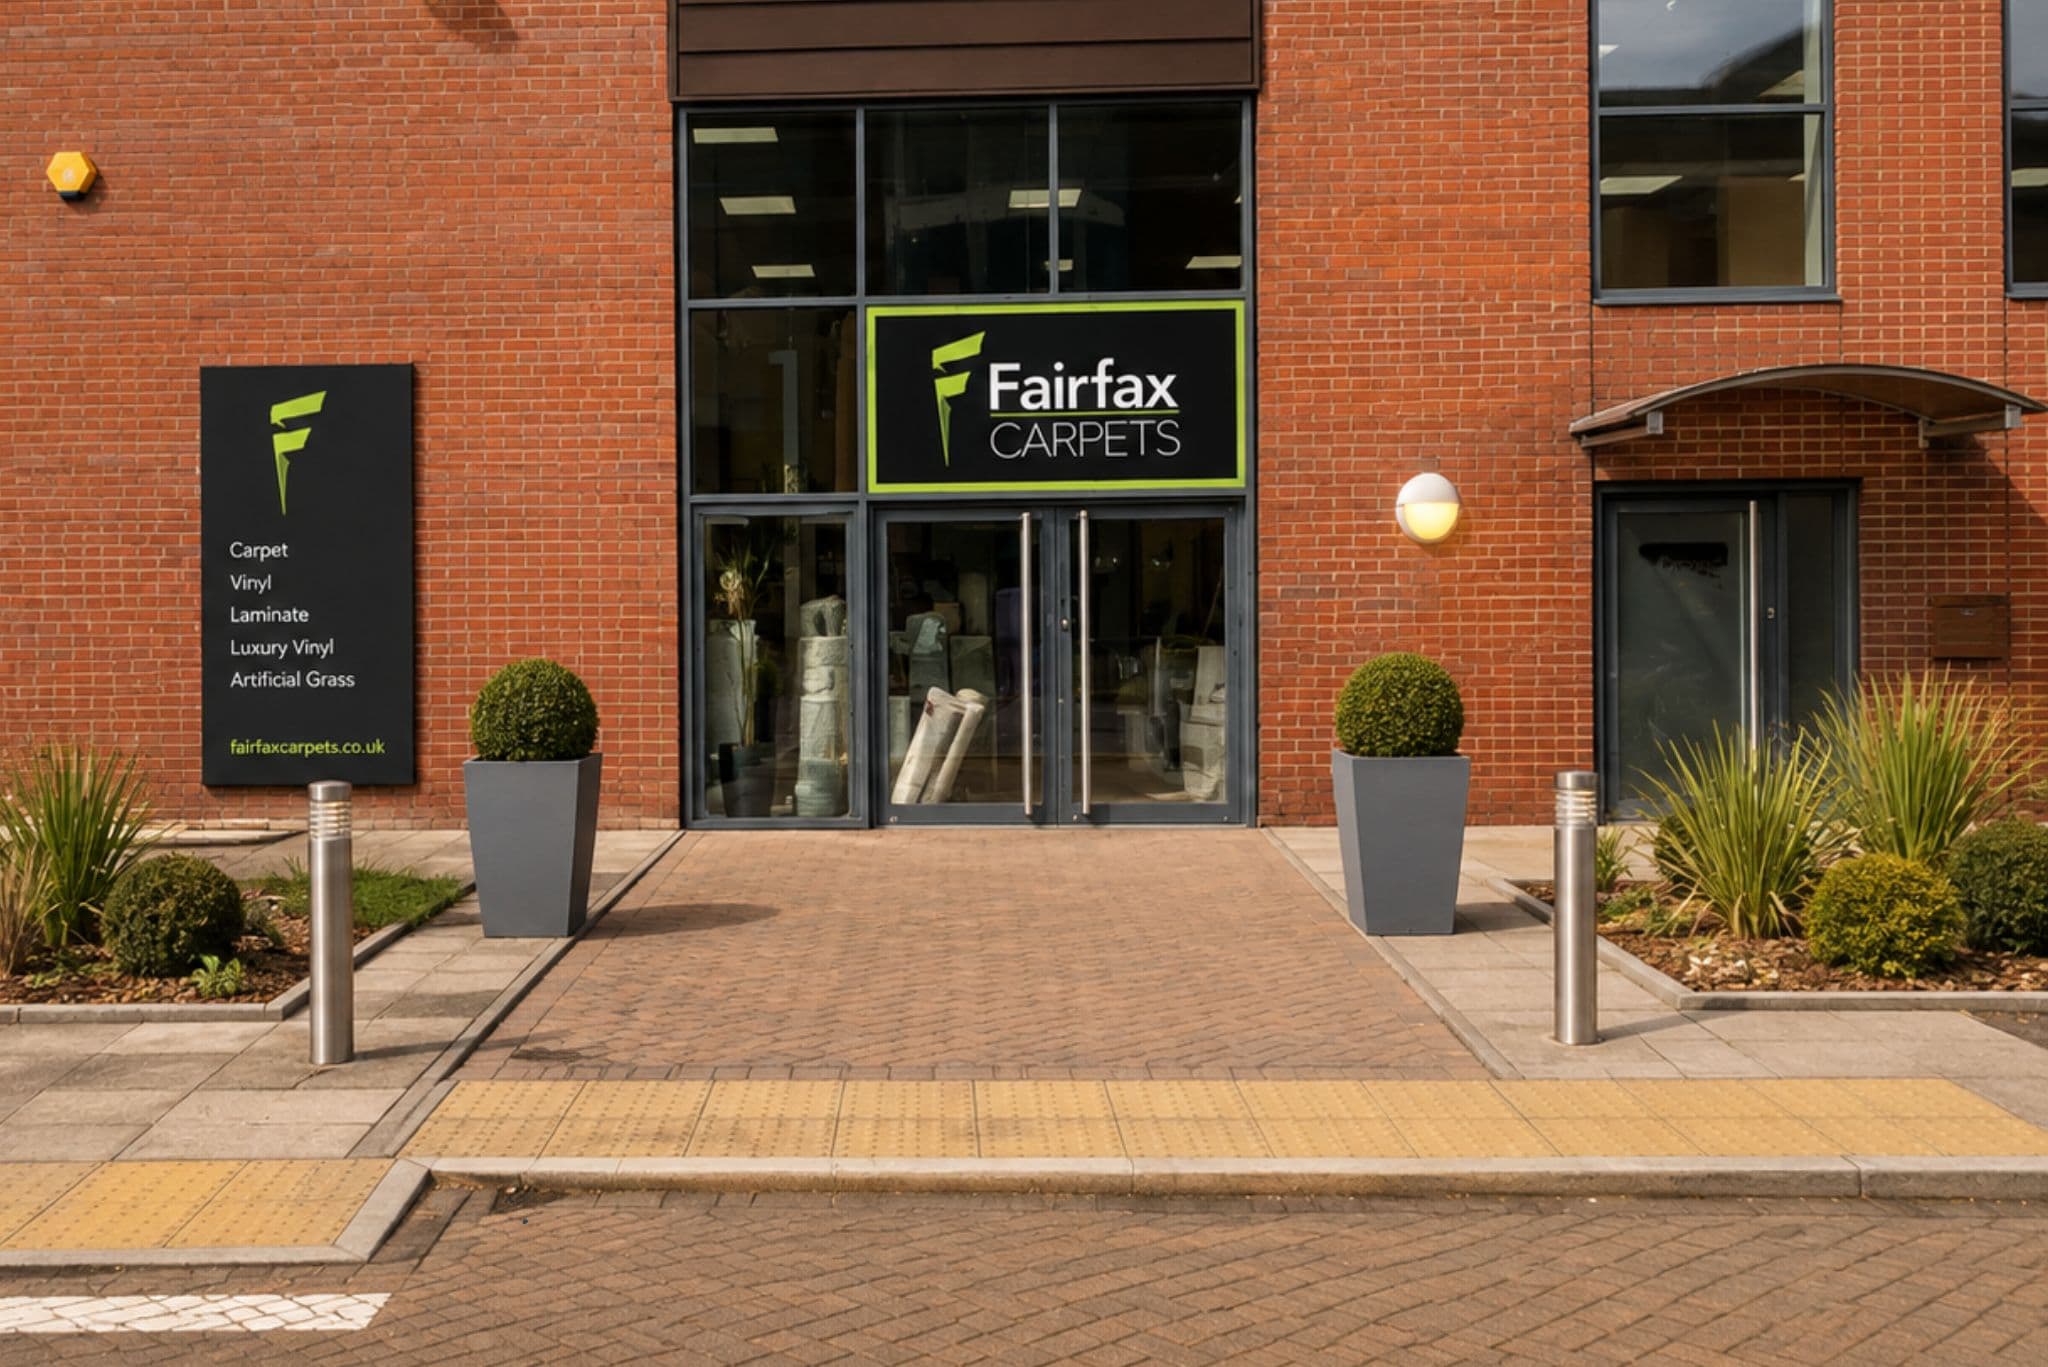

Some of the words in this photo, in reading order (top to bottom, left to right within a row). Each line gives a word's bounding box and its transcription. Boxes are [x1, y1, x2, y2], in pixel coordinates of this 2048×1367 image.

[989, 357, 1178, 410] Fairfax
[990, 419, 1181, 459] CARPETS
[229, 541, 289, 562] Carpet
[229, 574, 272, 595] Vinyl
[230, 605, 310, 623] Laminate
[230, 639, 288, 660] Luxury
[291, 638, 334, 660] Vinyl
[229, 670, 301, 688] Artificial
[305, 670, 356, 689] Grass
[230, 738, 386, 759] fairfaxcarpets.co.uk
